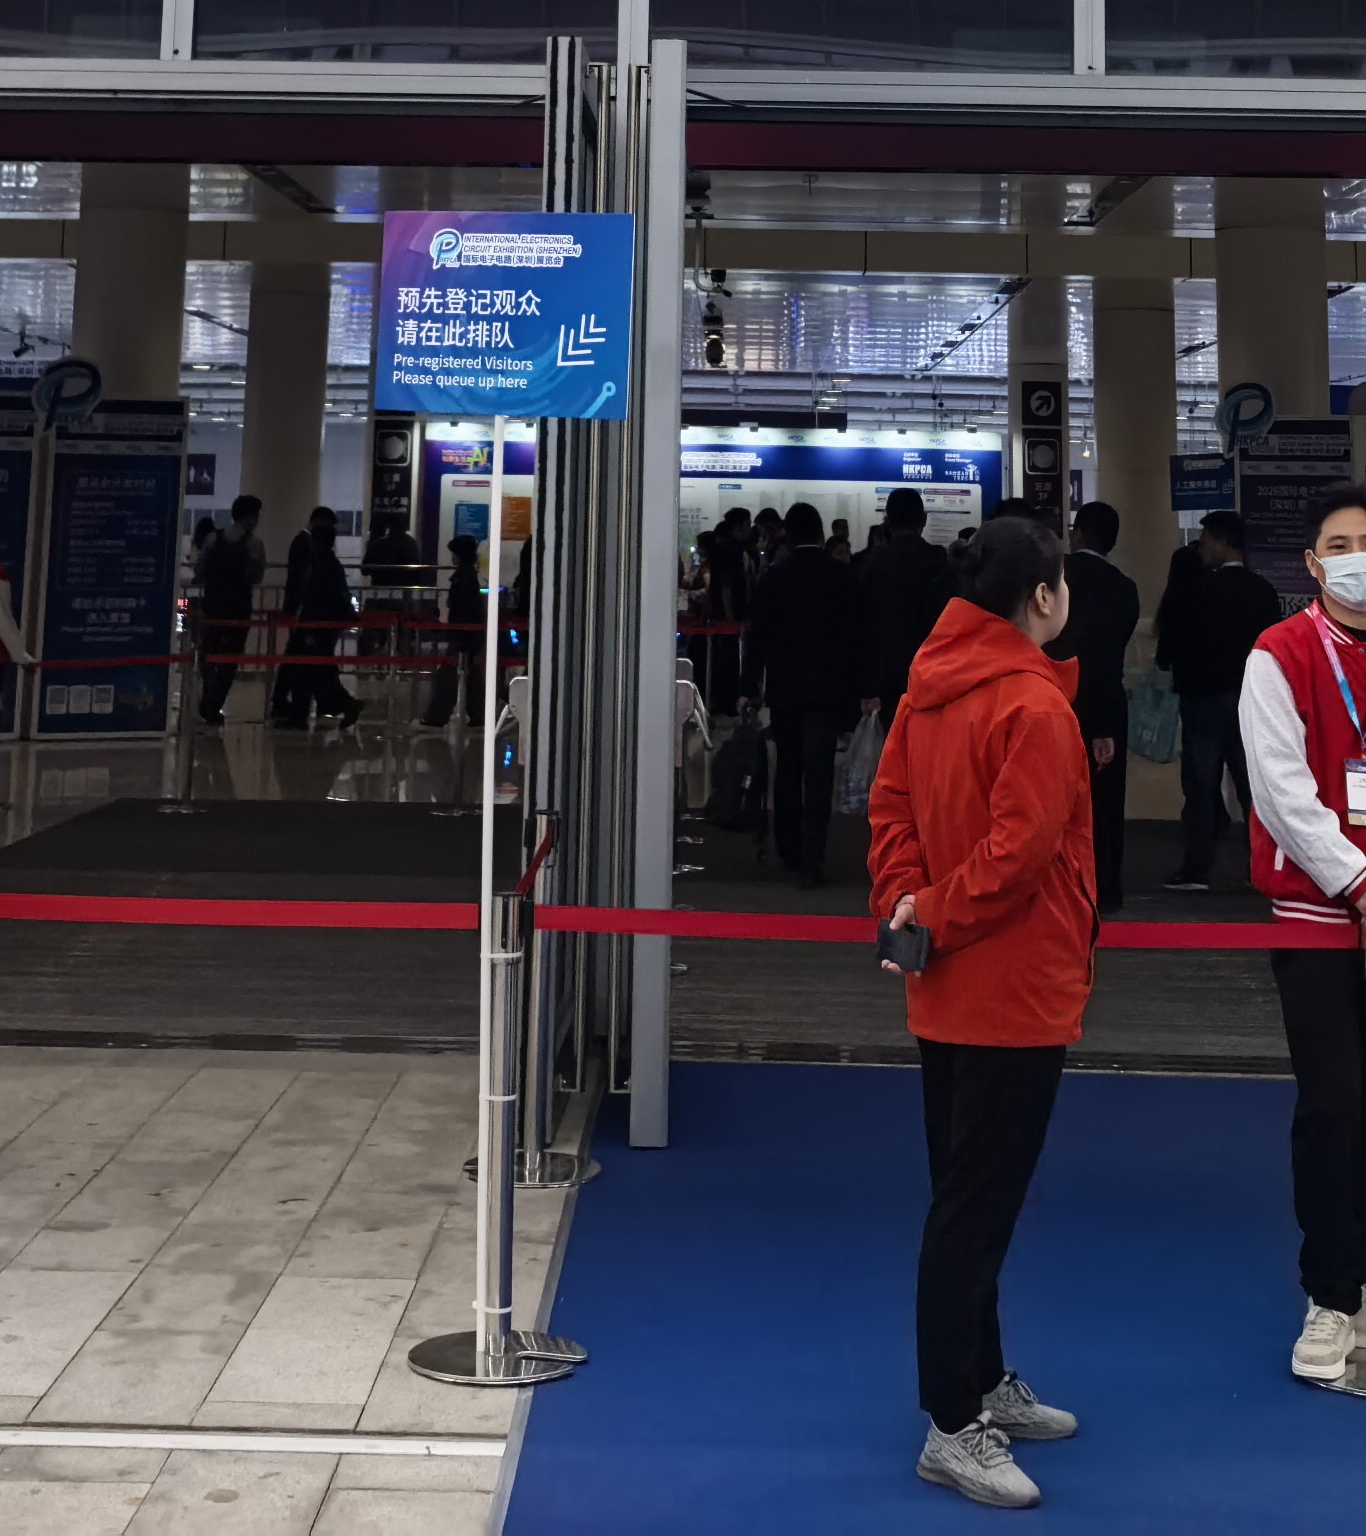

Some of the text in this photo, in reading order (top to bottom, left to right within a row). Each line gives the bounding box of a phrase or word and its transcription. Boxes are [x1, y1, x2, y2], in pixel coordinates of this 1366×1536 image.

[463, 244, 491, 253] CIRCUIT
[493, 245, 534, 254] EXHIBITION
[464, 235, 572, 245] INTERNATIONAL ELECTRONICS
[397, 287, 542, 316] 预先登记观众
[396, 320, 515, 348] 请在此排队
[394, 354, 533, 372] Pre-registered Visitors
[393, 370, 528, 390] Please queue up here
